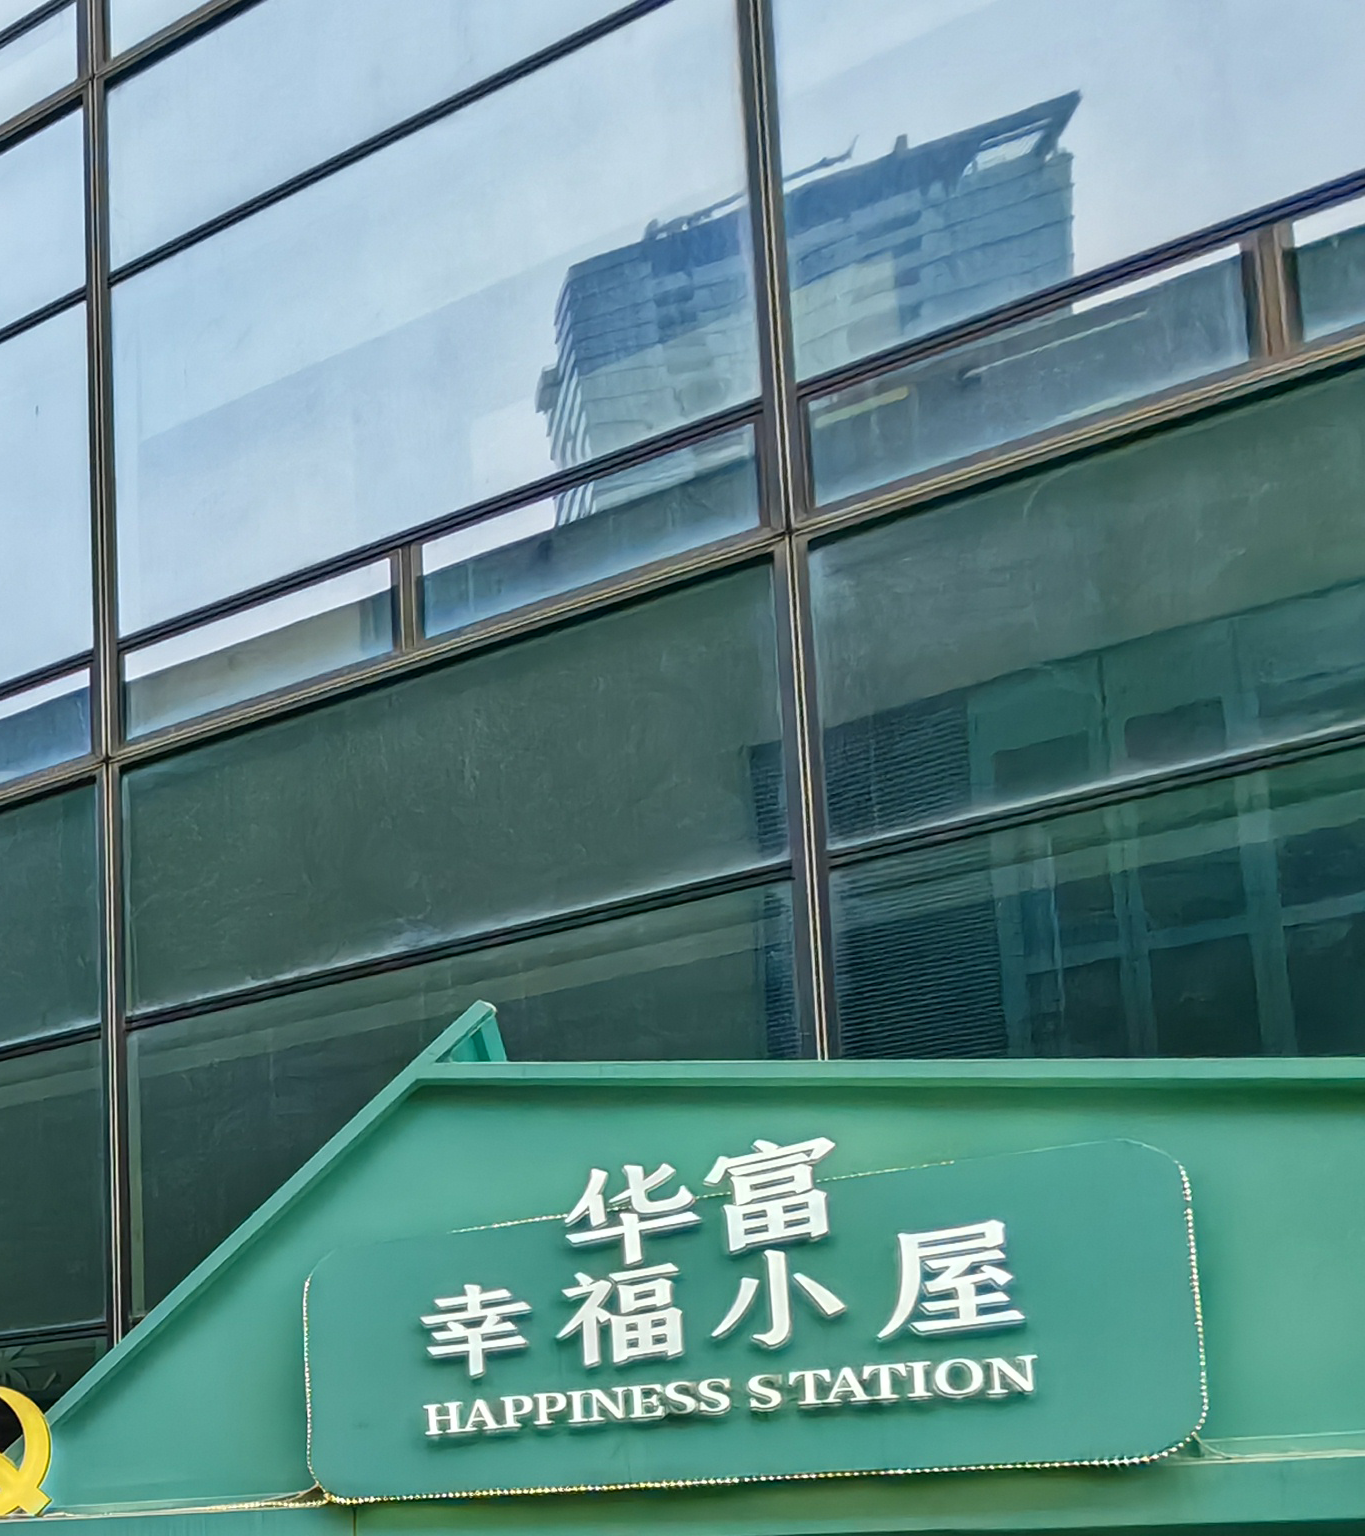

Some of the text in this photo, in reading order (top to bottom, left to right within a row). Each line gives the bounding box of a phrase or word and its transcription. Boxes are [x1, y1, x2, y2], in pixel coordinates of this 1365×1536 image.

[564, 1137, 837, 1265] 华富
[419, 1220, 1027, 1378] 幸福小屋
[422, 1353, 1038, 1438] HAPPINESS STATION
